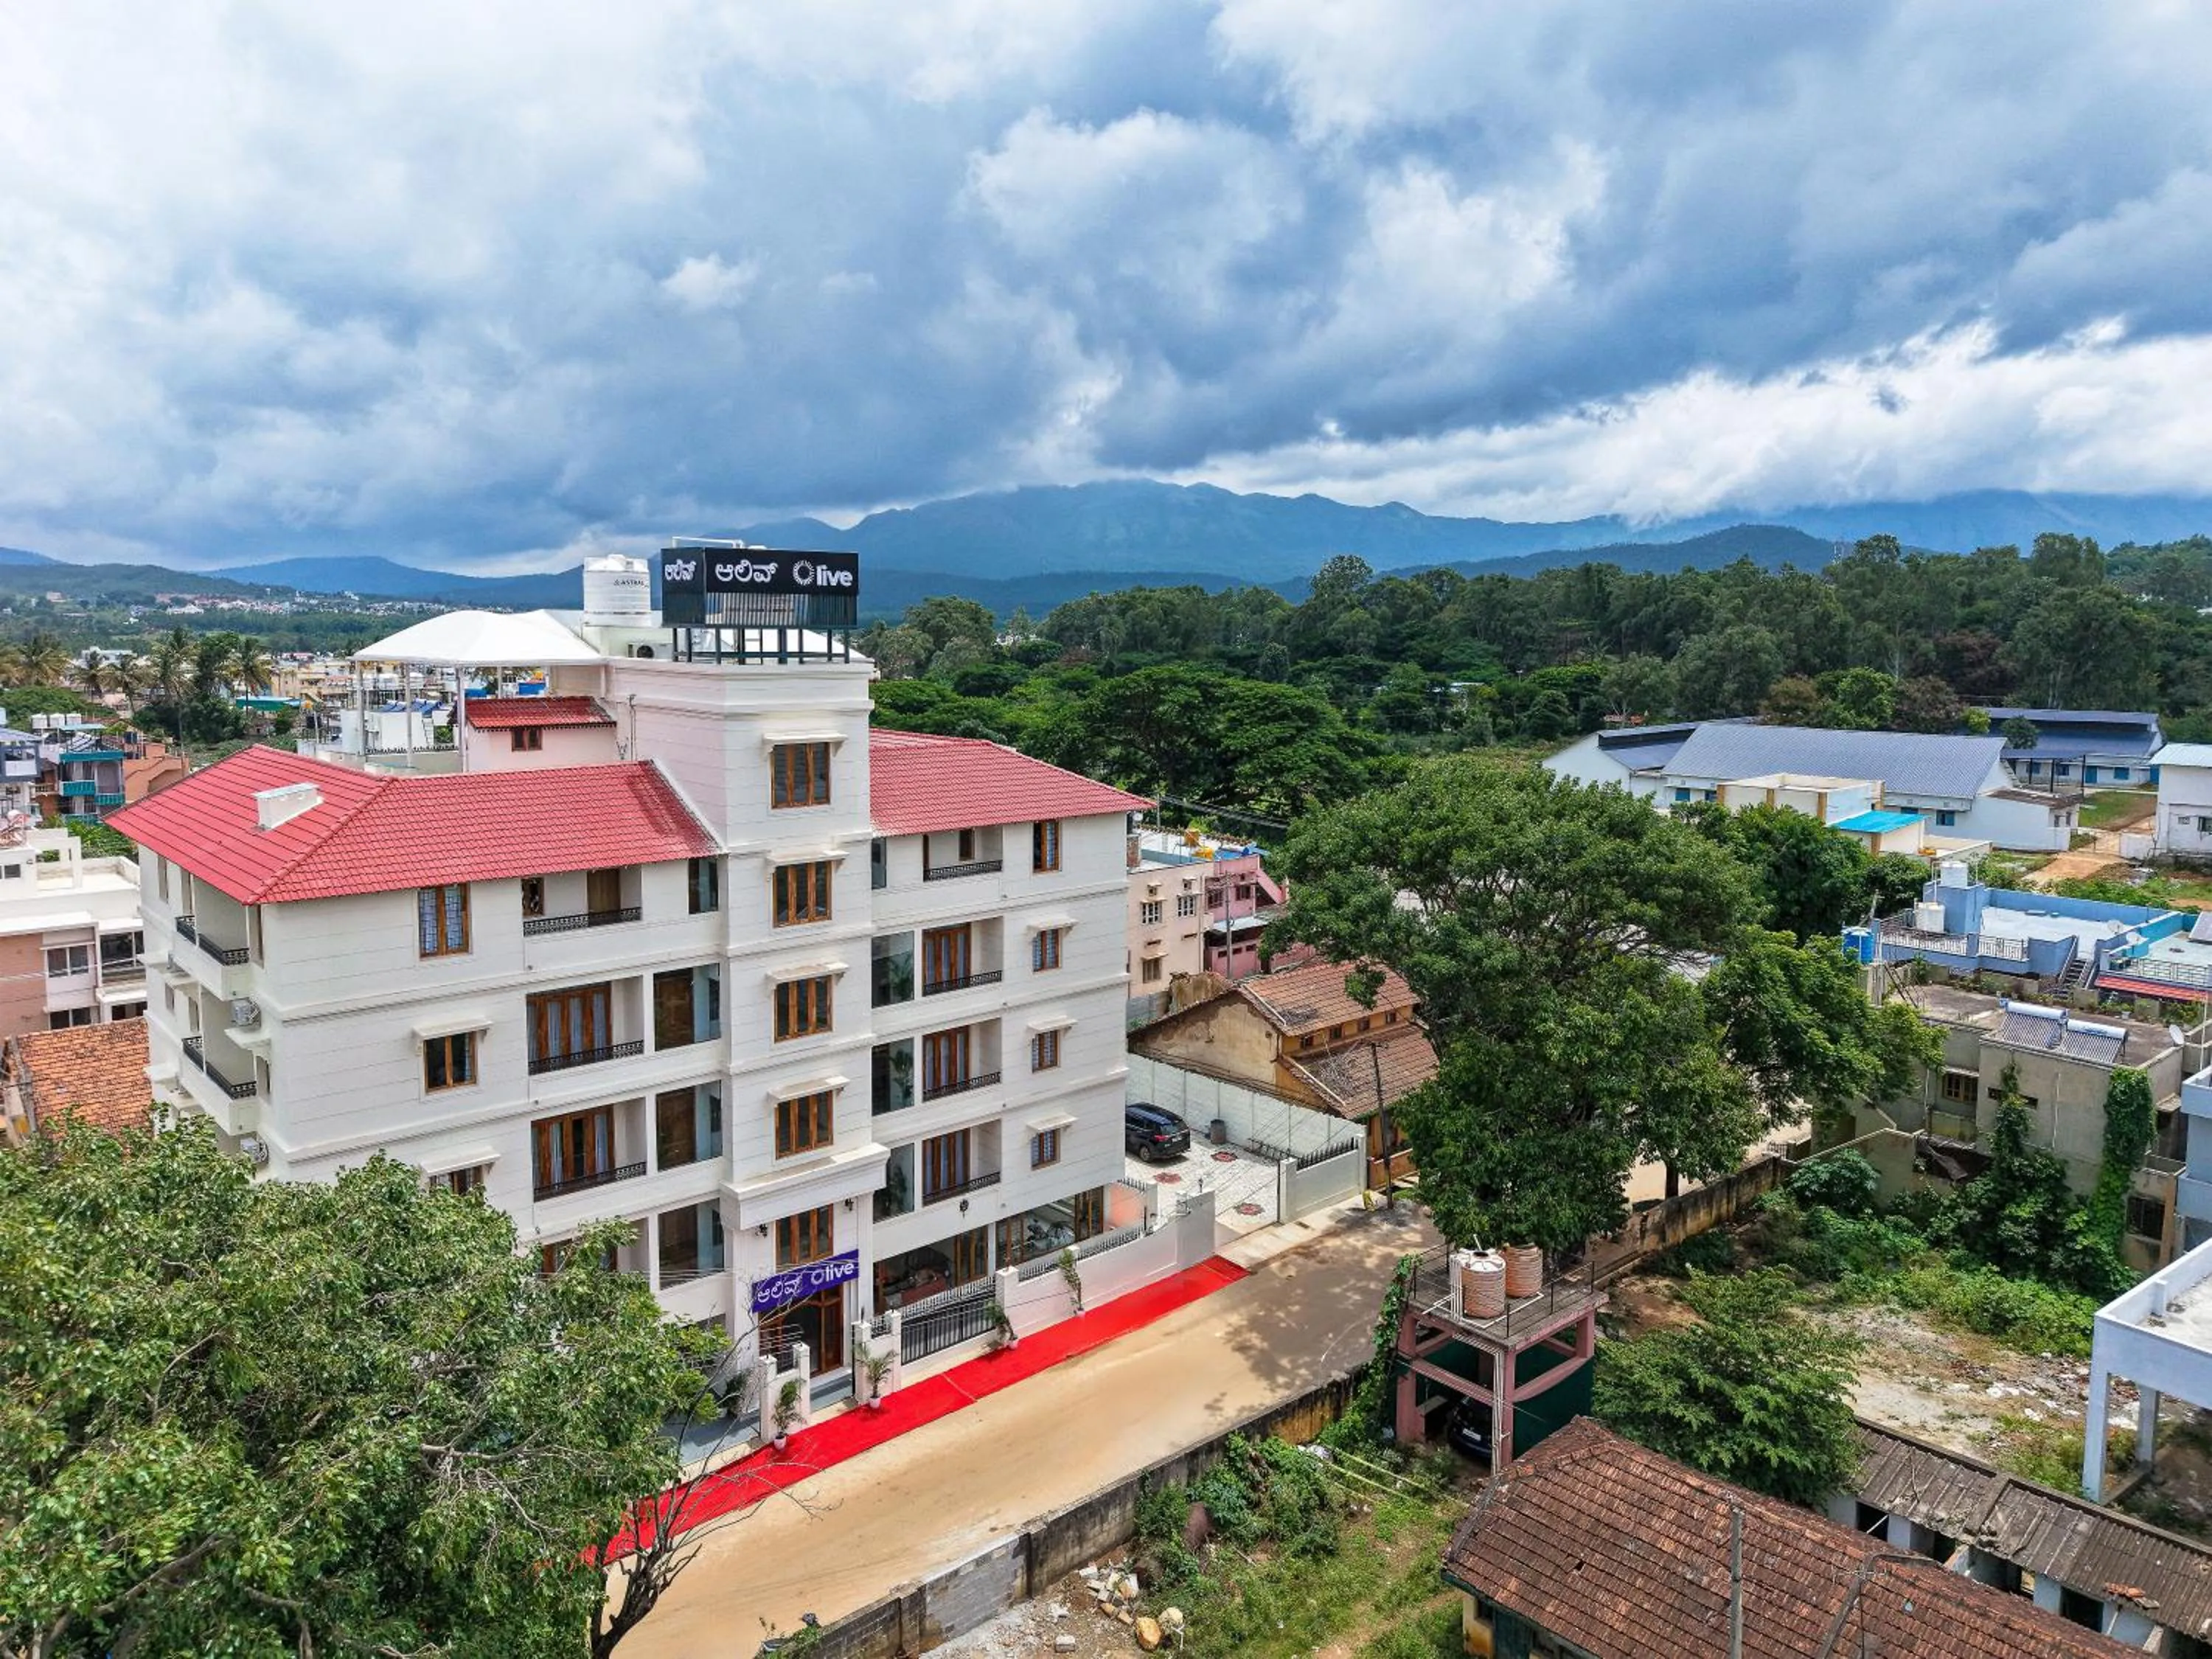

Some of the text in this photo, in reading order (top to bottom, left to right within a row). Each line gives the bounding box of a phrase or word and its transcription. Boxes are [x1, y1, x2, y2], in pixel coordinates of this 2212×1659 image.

[715, 559, 779, 582] ಆಲಿವ್
[793, 560, 853, 587] Olive
[810, 1263, 854, 1284] Olive
